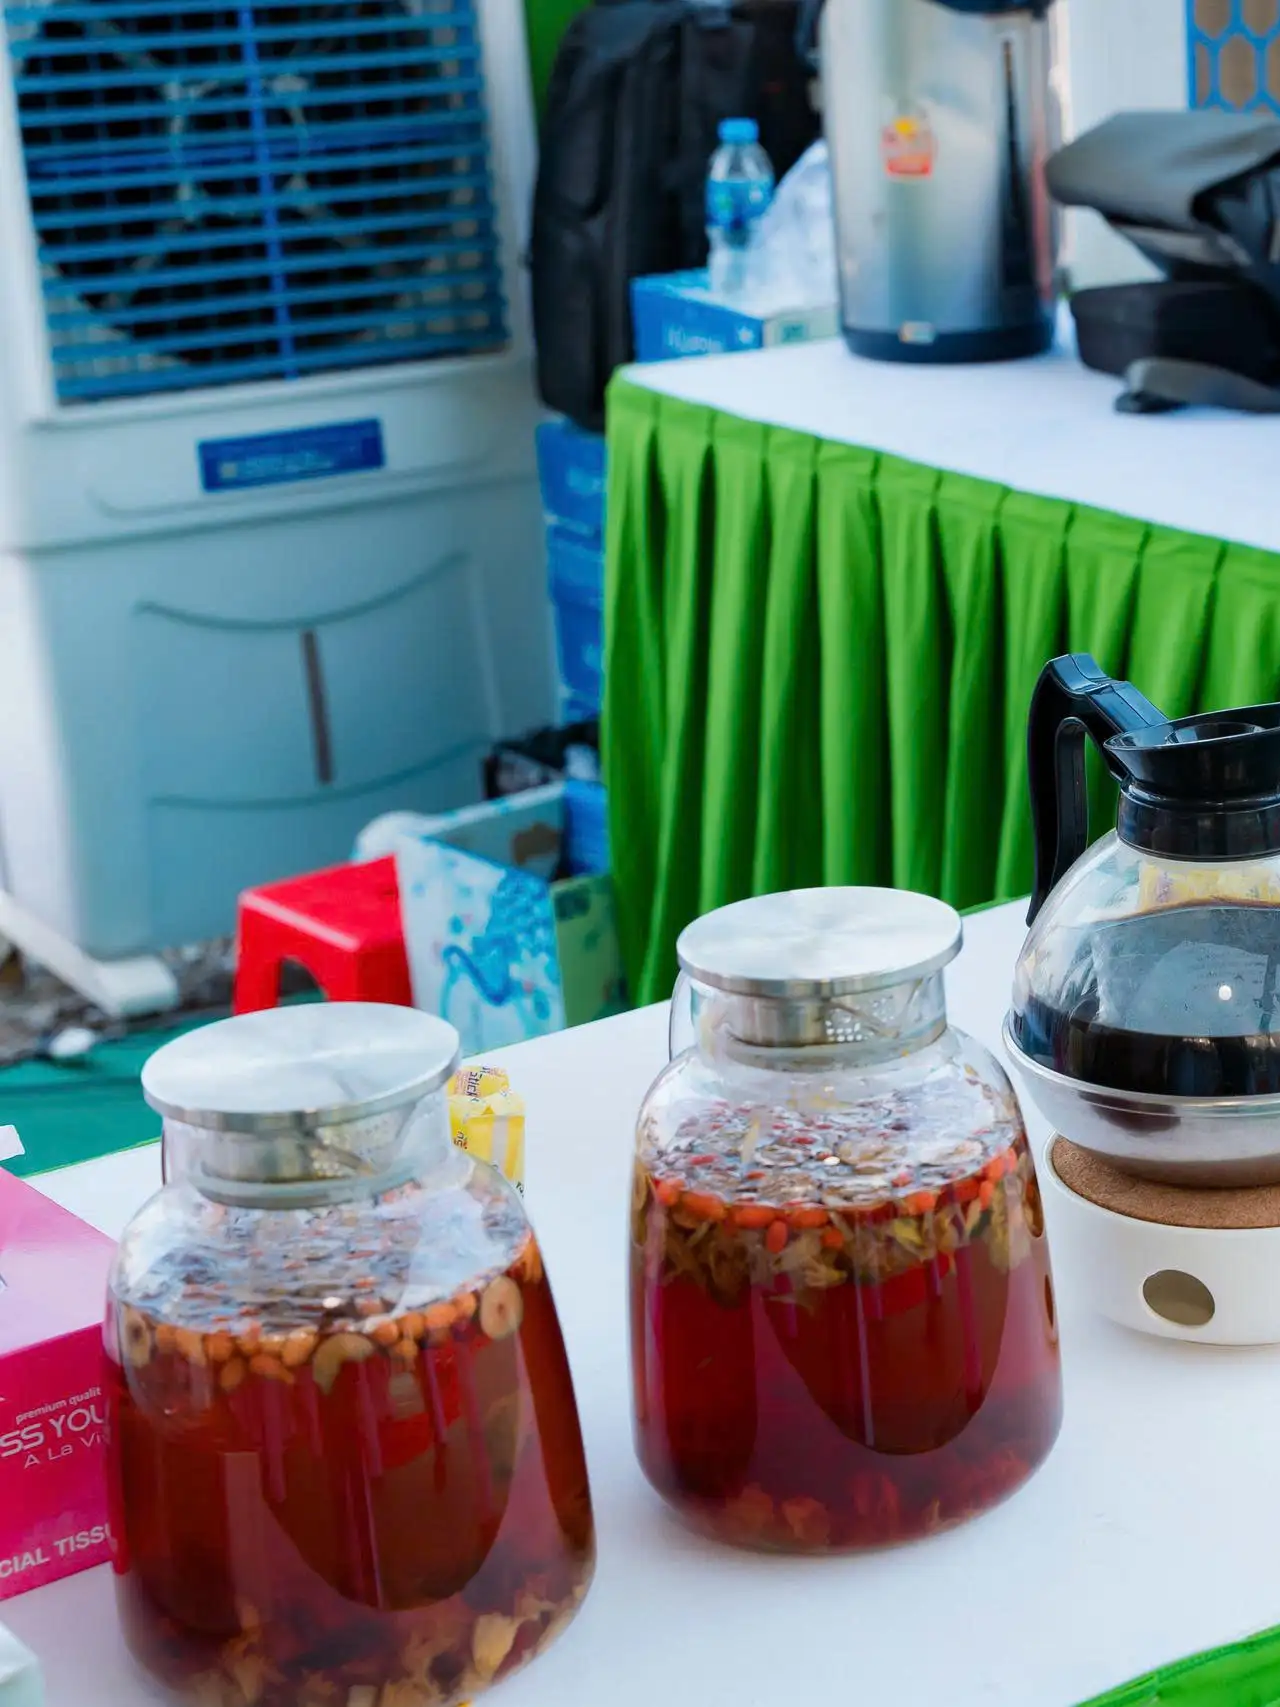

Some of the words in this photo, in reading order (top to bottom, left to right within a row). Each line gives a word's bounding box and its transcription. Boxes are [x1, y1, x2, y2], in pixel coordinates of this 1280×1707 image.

[16, 1399, 67, 1425] premium
[69, 1386, 102, 1406] qualit
[47, 1444, 73, 1461] La
[80, 1431, 101, 1448] Vi
[0, 1547, 50, 1579] CIAL
